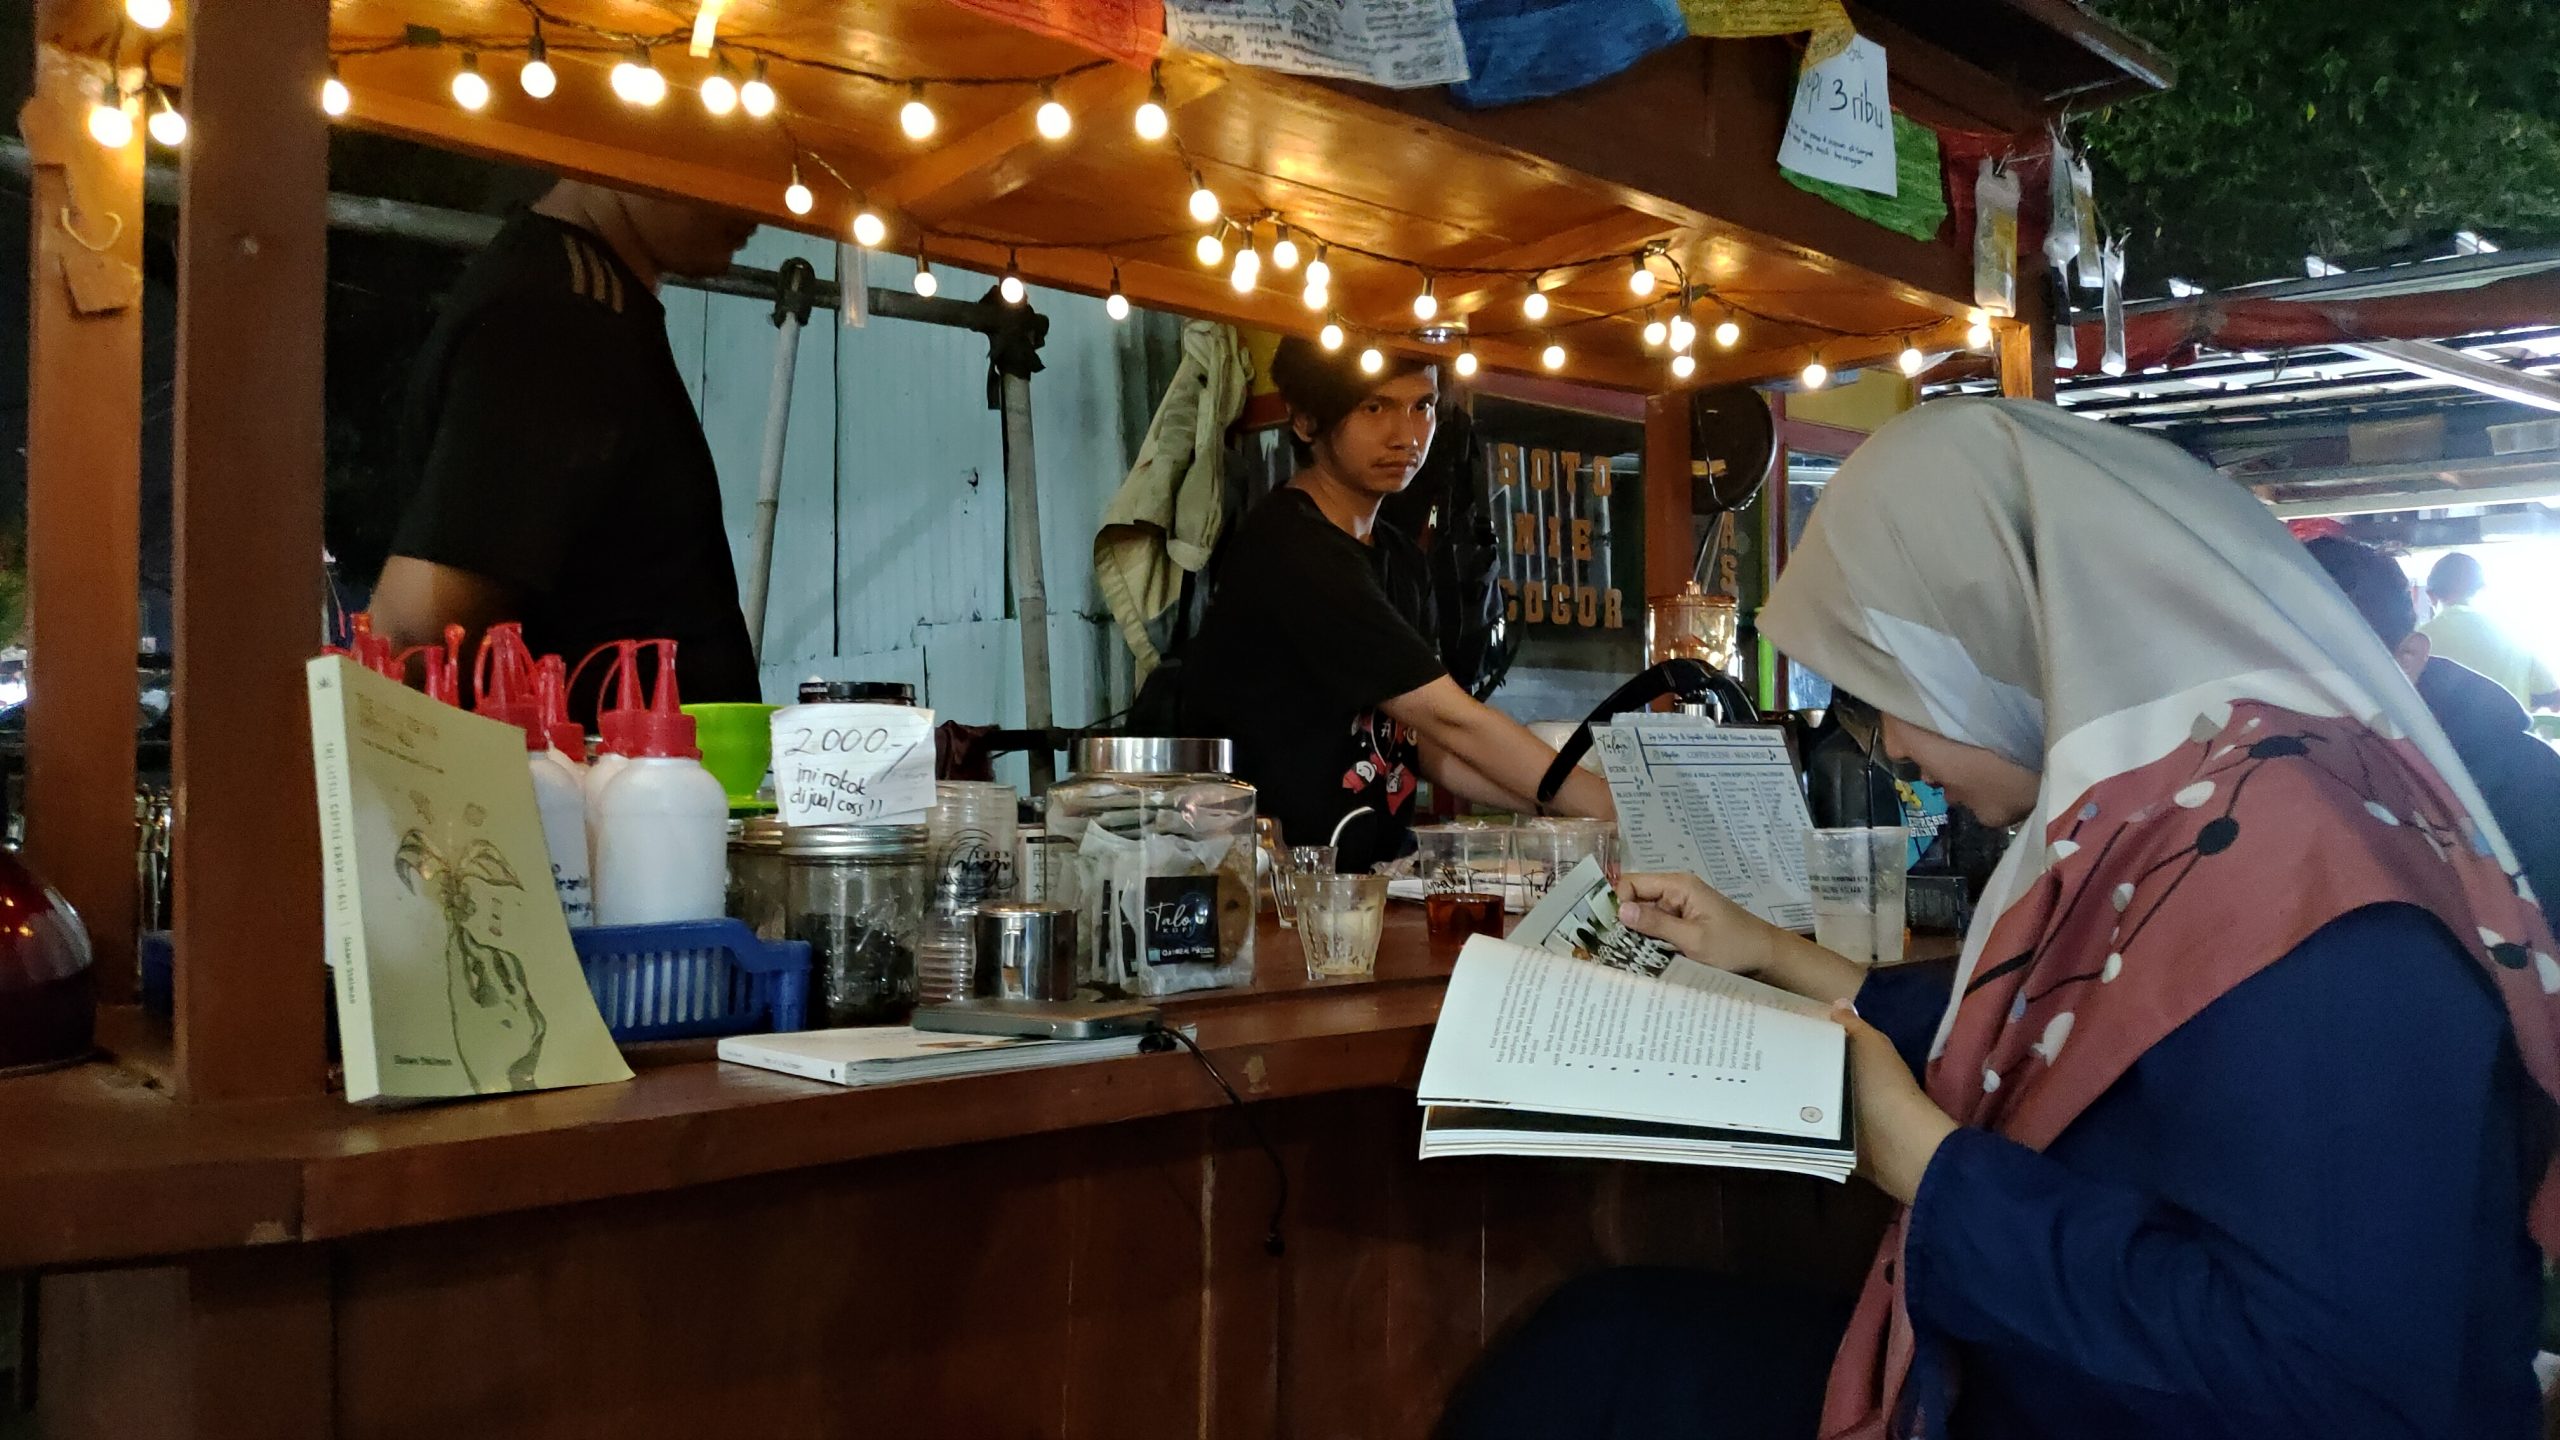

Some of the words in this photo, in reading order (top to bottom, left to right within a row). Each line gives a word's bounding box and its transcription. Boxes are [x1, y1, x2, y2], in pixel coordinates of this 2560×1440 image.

[1829, 78, 1848, 111] 3
[1852, 77, 1884, 130] ribu
[1497, 443, 1612, 497] SOTO
[1514, 512, 1593, 561] MIE
[797, 763, 820, 783] ini
